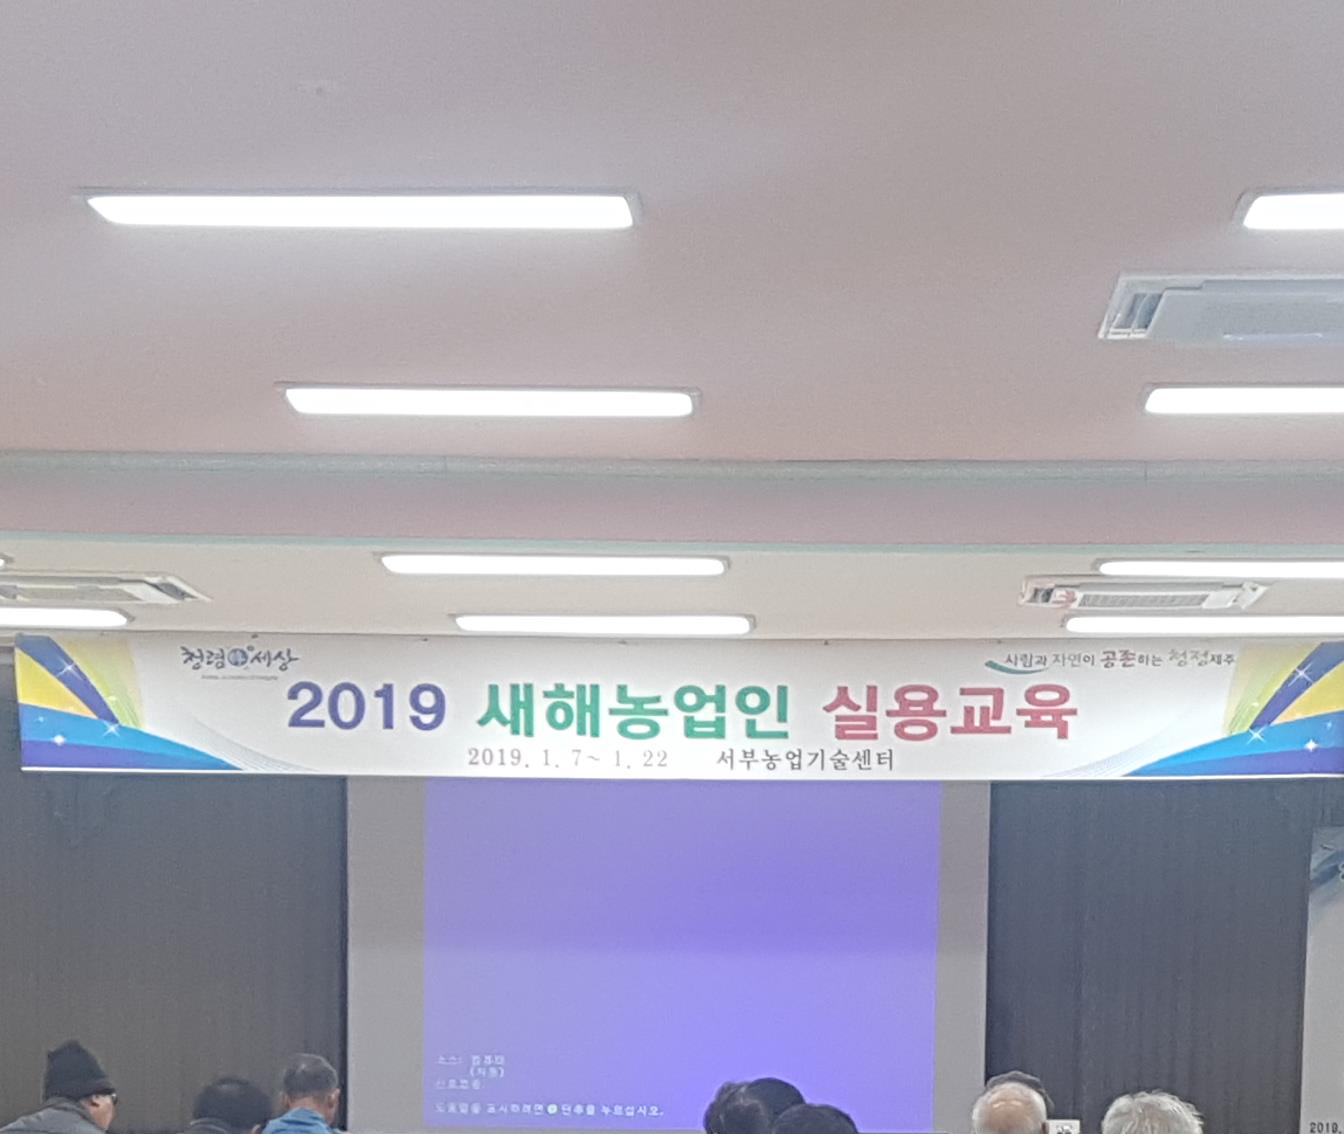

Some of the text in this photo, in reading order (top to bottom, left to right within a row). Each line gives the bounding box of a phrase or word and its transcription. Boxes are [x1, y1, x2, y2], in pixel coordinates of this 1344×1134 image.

[1052, 652, 1095, 667] 자연이
[1100, 650, 1163, 668] 공존하는
[1168, 649, 1235, 667] 청정제주
[287, 682, 1078, 742] 2019 새해농업인 실용교육
[468, 748, 531, 769] 2019.
[643, 751, 668, 768] 22
[717, 747, 894, 772] 서부농업기술센터
